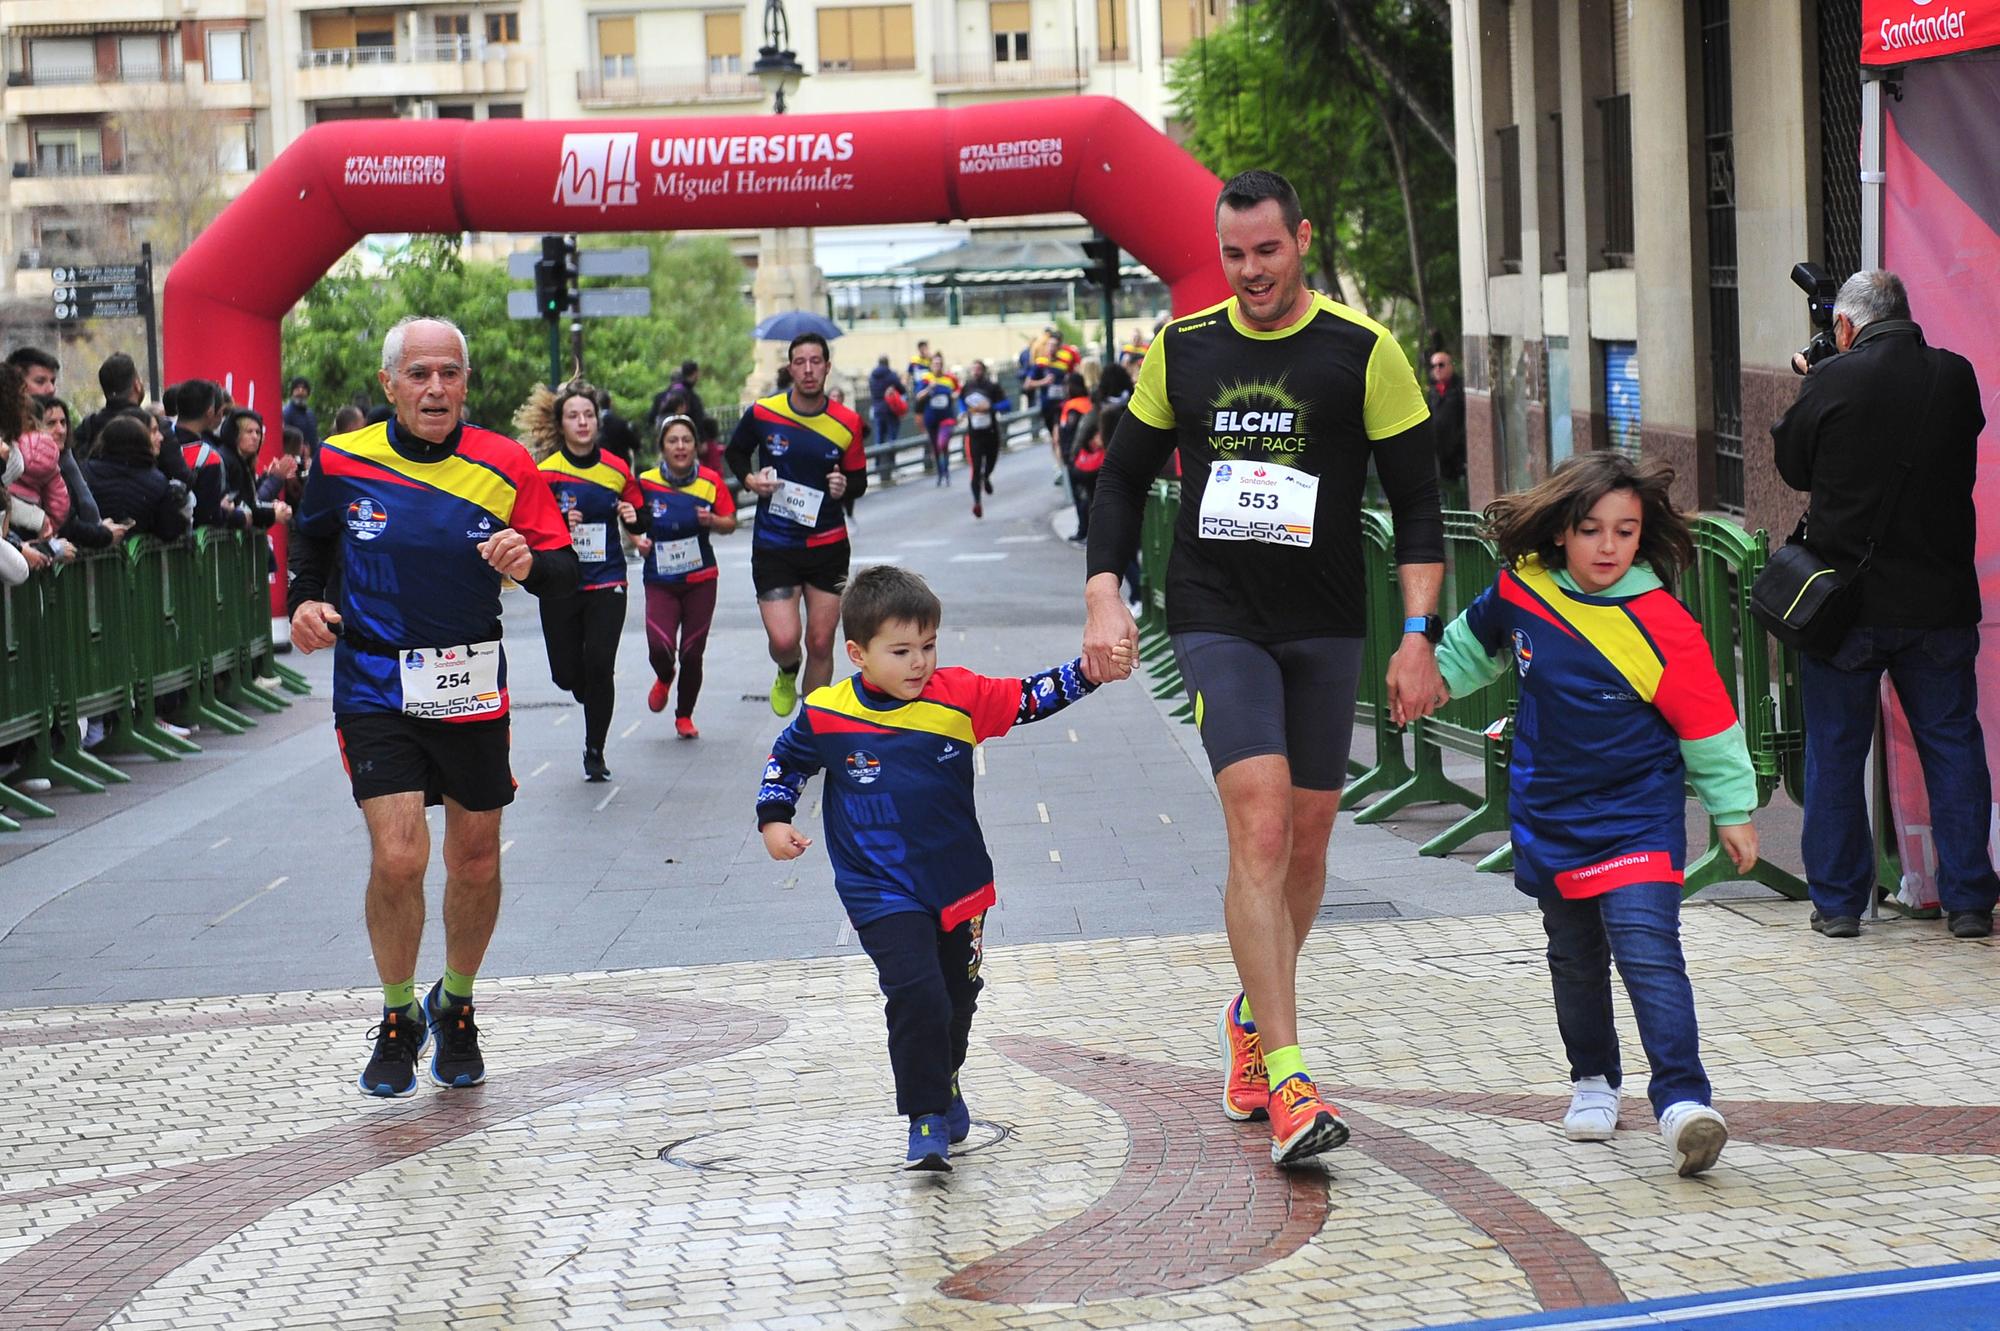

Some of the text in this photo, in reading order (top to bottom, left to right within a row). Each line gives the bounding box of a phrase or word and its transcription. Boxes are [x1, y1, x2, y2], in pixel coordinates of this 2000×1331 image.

[1880, 6, 1966, 51] Santander
[650, 132, 854, 167] UNIVERSITAS
[960, 138, 1063, 159] #TALENTOEN
[345, 155, 446, 171] #TALENTOEN
[960, 151, 1063, 174] MOVIMIENTO
[344, 168, 446, 185] MOVIMIENTO
[653, 166, 854, 201] Miguel Hernández
[1214, 411, 1294, 433] ELCHE
[1207, 435, 1307, 452] NIGHT RACE
[1239, 476, 1278, 487] Santander
[786, 496, 805, 508] 600
[1238, 491, 1279, 510] 553
[1202, 516, 1289, 533] POLICIA
[1202, 526, 1310, 544] NACIONAL
[434, 659, 466, 668] Santander
[436, 671, 471, 689] 254
[404, 701, 500, 716] NACIONAL
[405, 695, 479, 709] POLICIA
[1571, 854, 1649, 880] @policianacional
